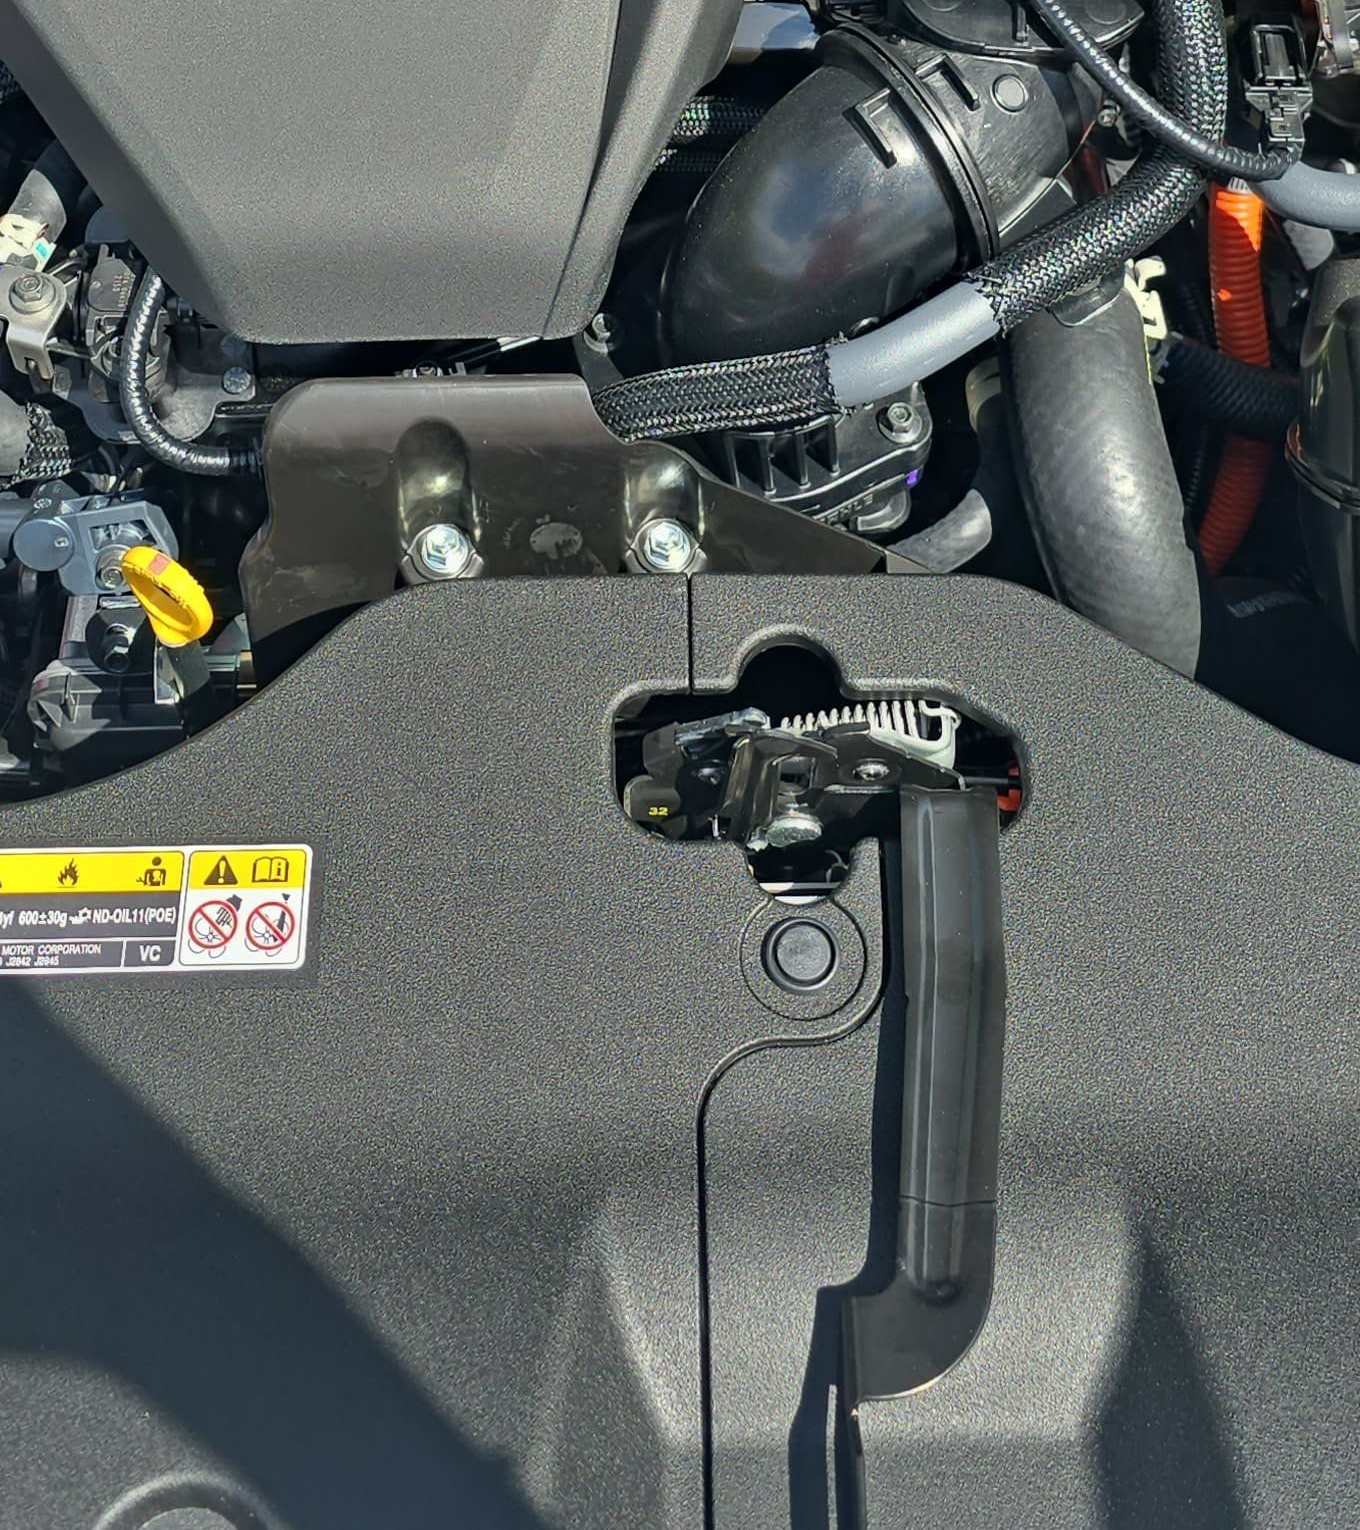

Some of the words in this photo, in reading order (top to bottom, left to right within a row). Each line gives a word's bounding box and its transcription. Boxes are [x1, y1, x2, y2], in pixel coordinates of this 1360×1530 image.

[648, 806, 669, 816] 32
[2, 944, 35, 956] MOTOR
[37, 943, 102, 955] CORPORATION
[139, 944, 163, 962] VC
